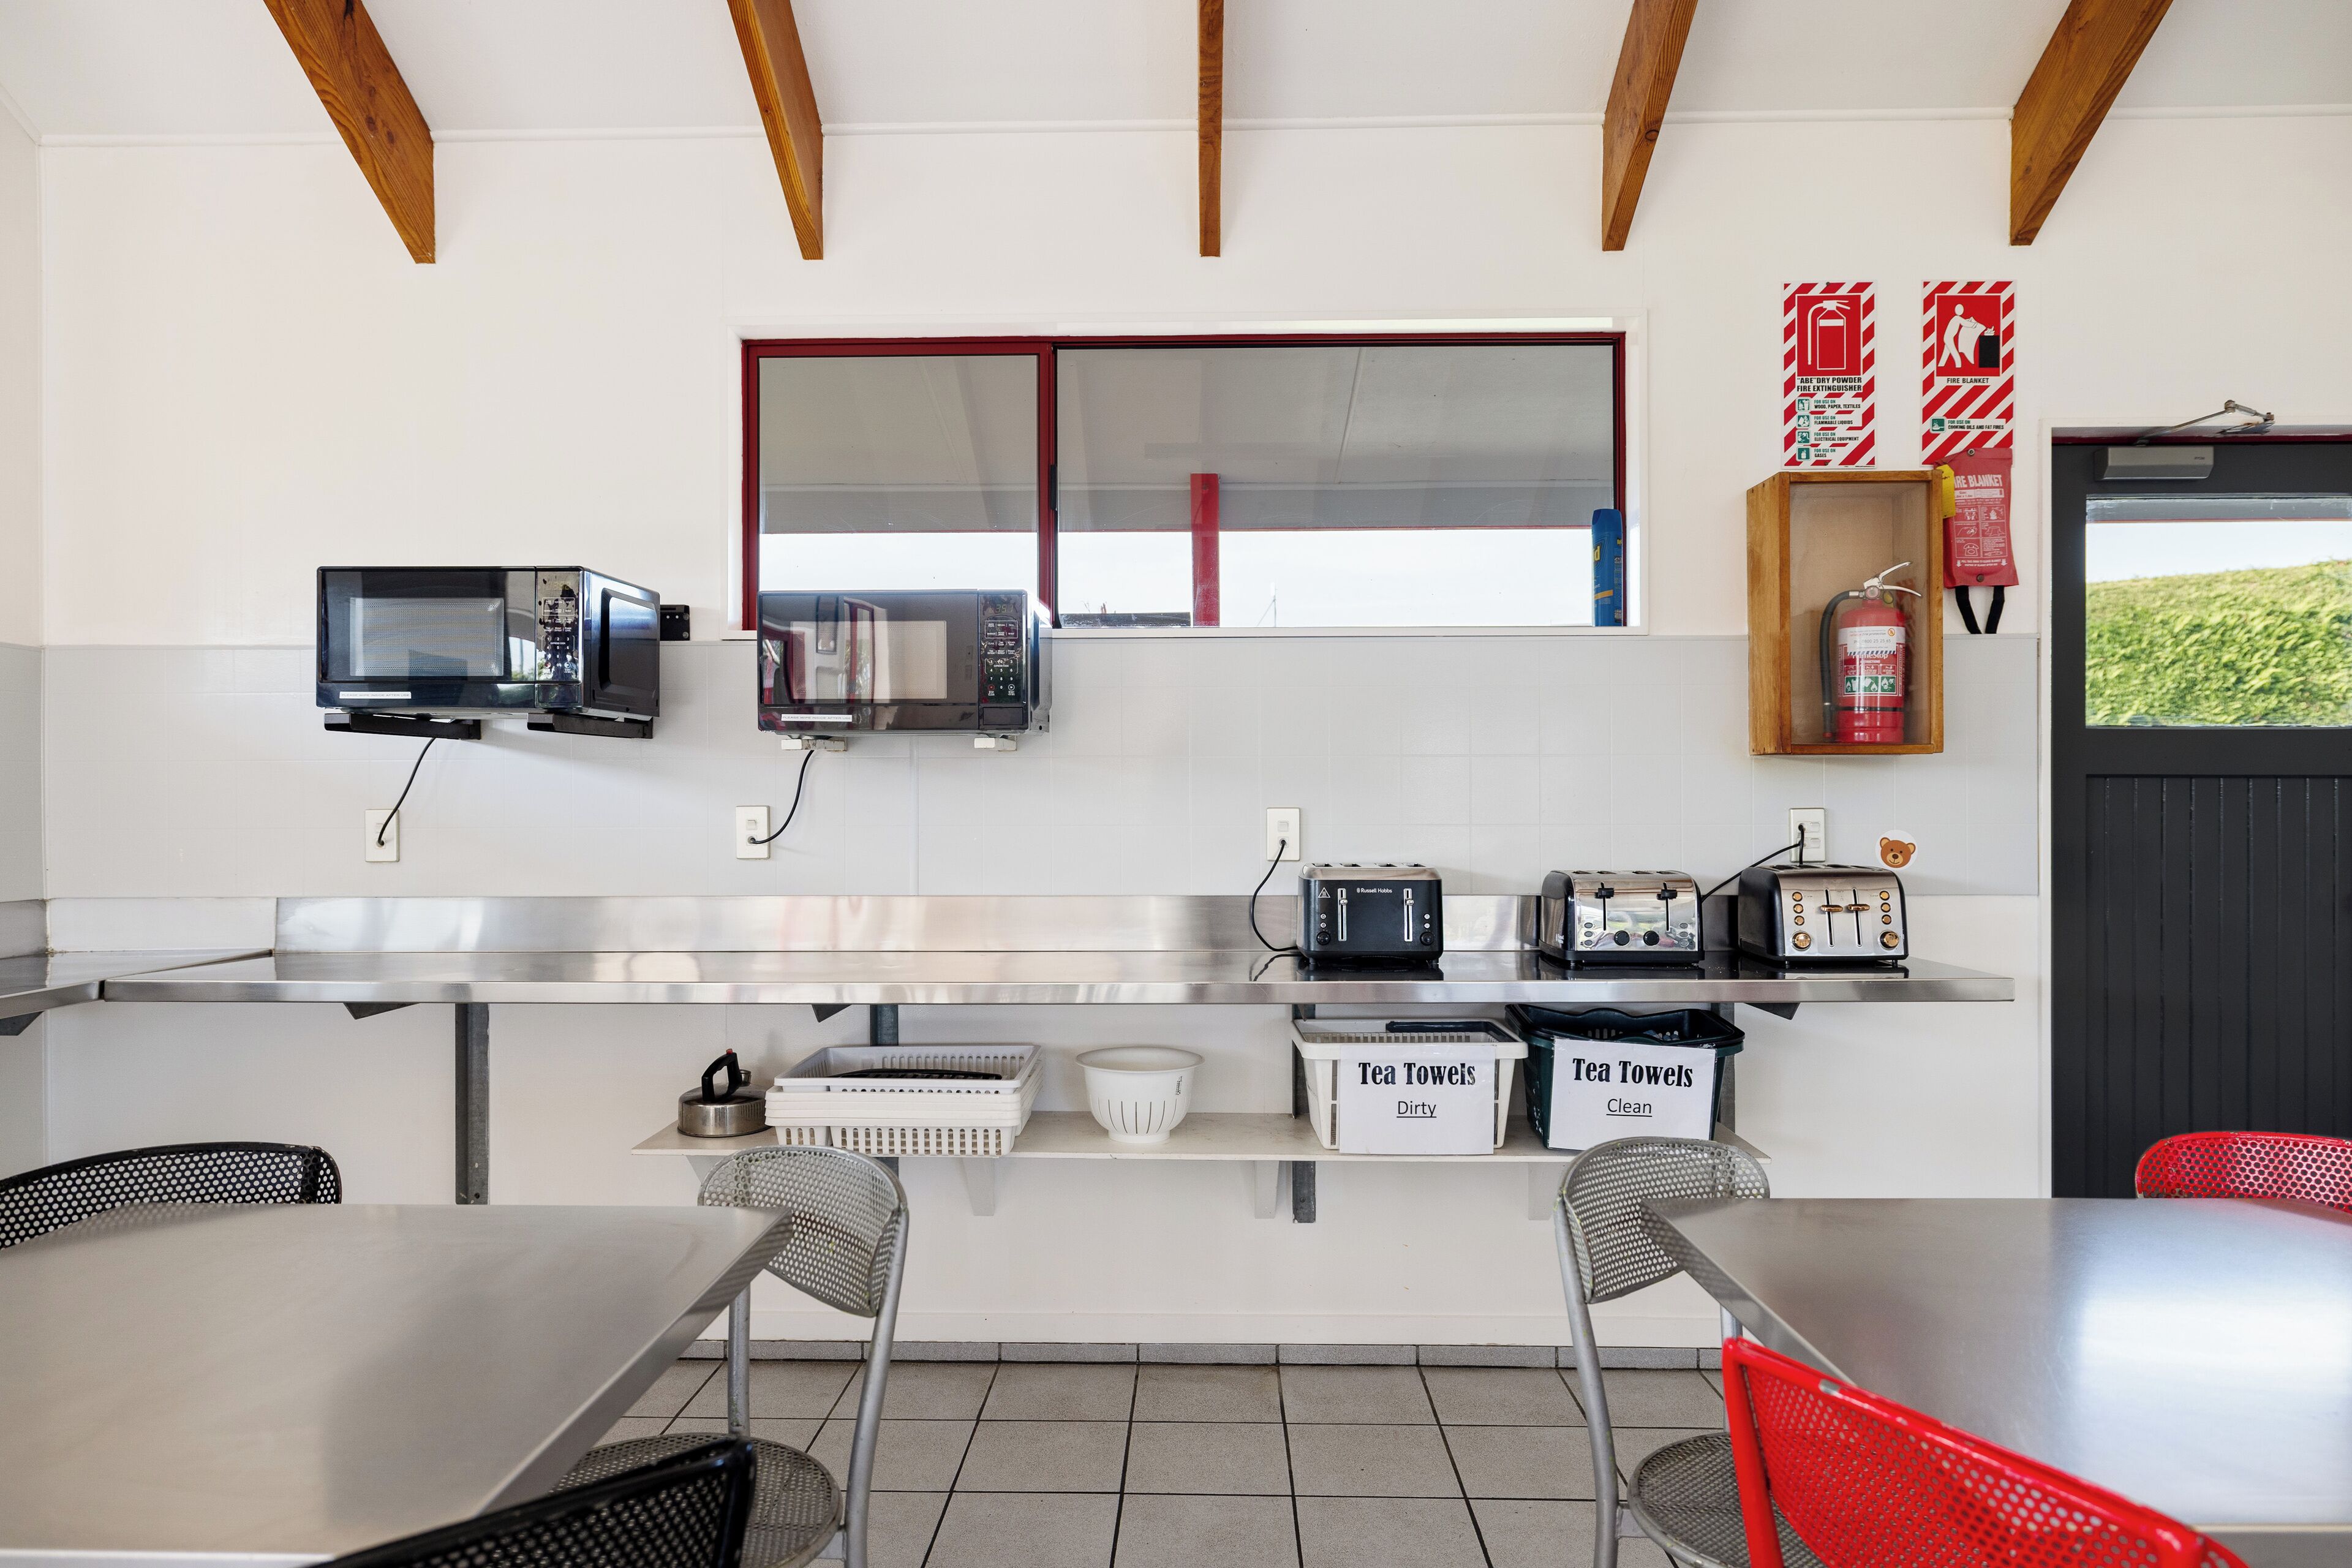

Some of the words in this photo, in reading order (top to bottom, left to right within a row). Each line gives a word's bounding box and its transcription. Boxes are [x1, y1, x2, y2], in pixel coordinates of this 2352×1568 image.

[1954, 475, 1967, 488] IRE
[1967, 474, 2002, 487] BLANKET
[1359, 1063, 1396, 1085] Tea
[1403, 1063, 1476, 1085] Towels
[1573, 1058, 1610, 1082] Tea
[1619, 1061, 1692, 1087] Towels
[1398, 1101, 1436, 1117] Dirty
[1607, 1098, 1652, 1114] Clean
